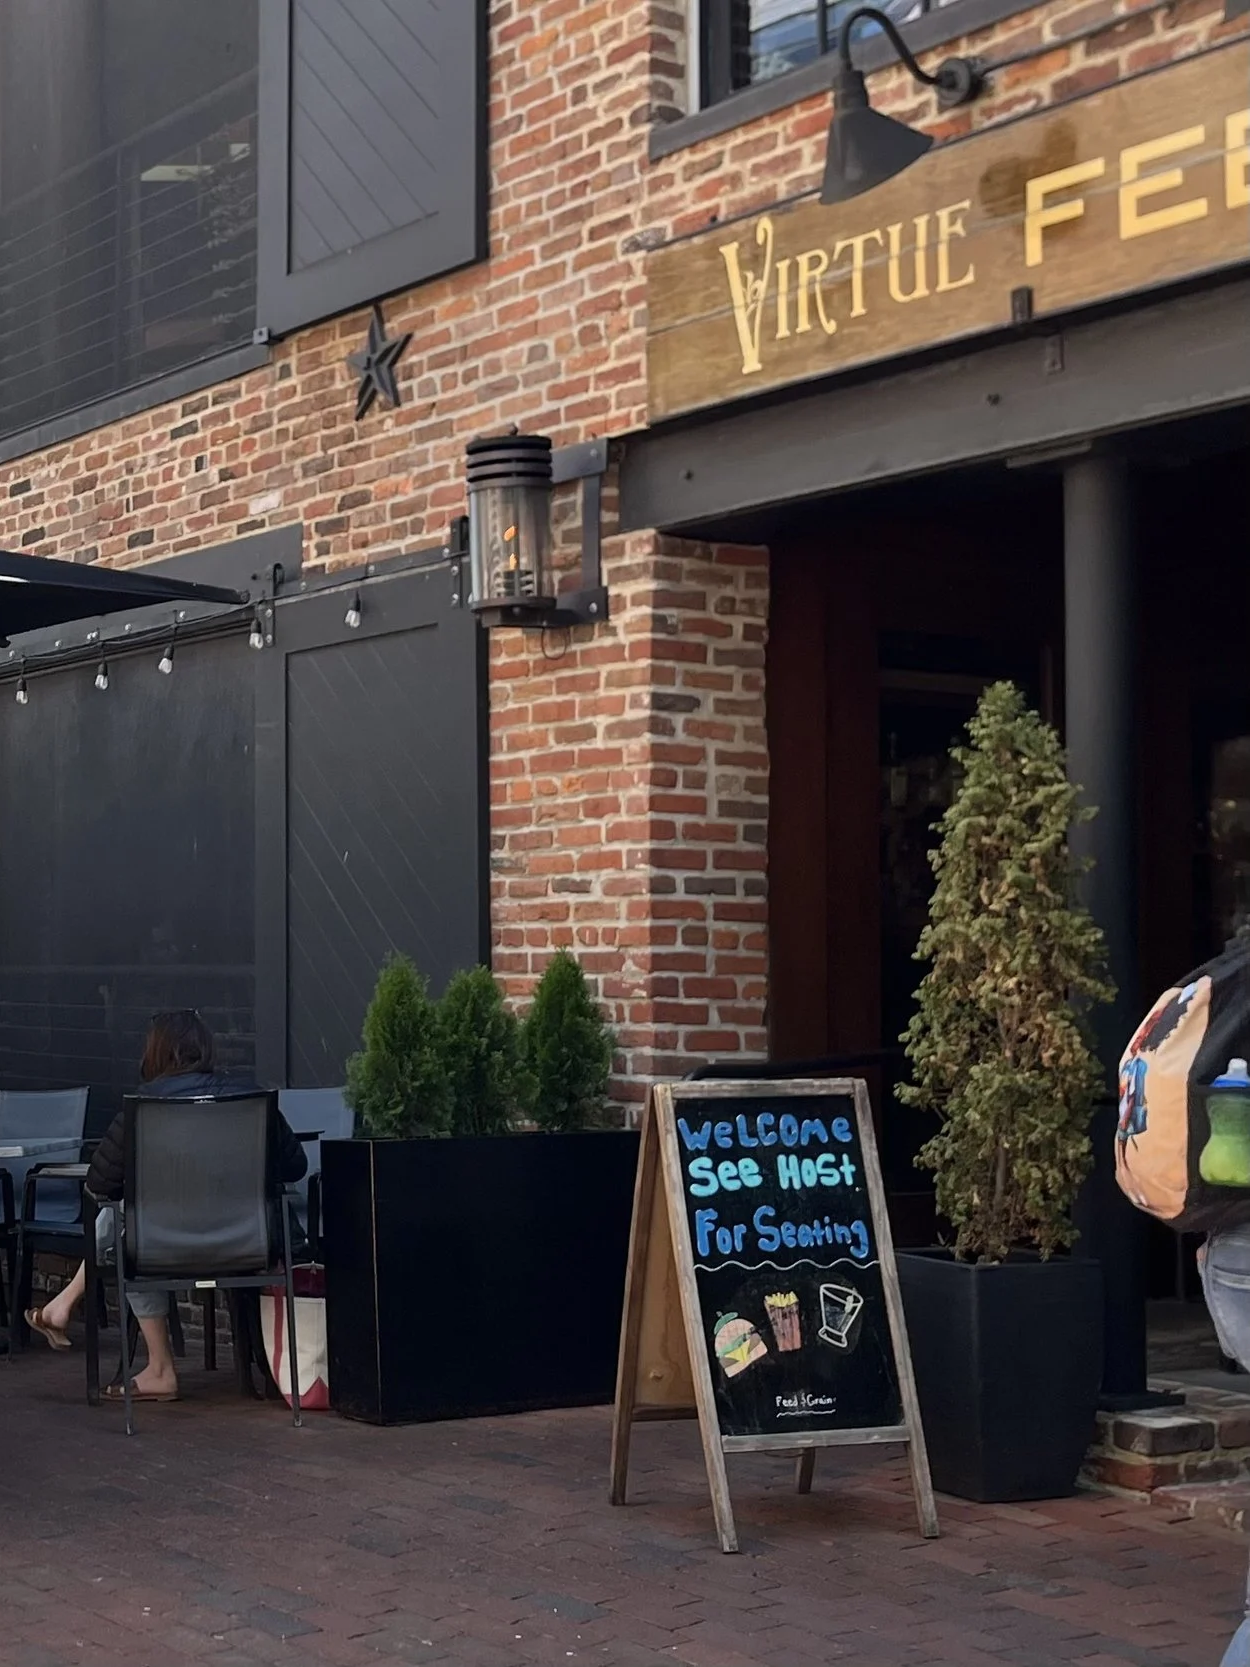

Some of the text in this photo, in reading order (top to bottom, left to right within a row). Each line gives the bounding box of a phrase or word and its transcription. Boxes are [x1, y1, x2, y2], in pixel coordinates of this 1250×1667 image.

[718, 107, 1250, 375] VIRTUE FE
[688, 1156, 763, 1197] See
[695, 1205, 869, 1259] For Seating
